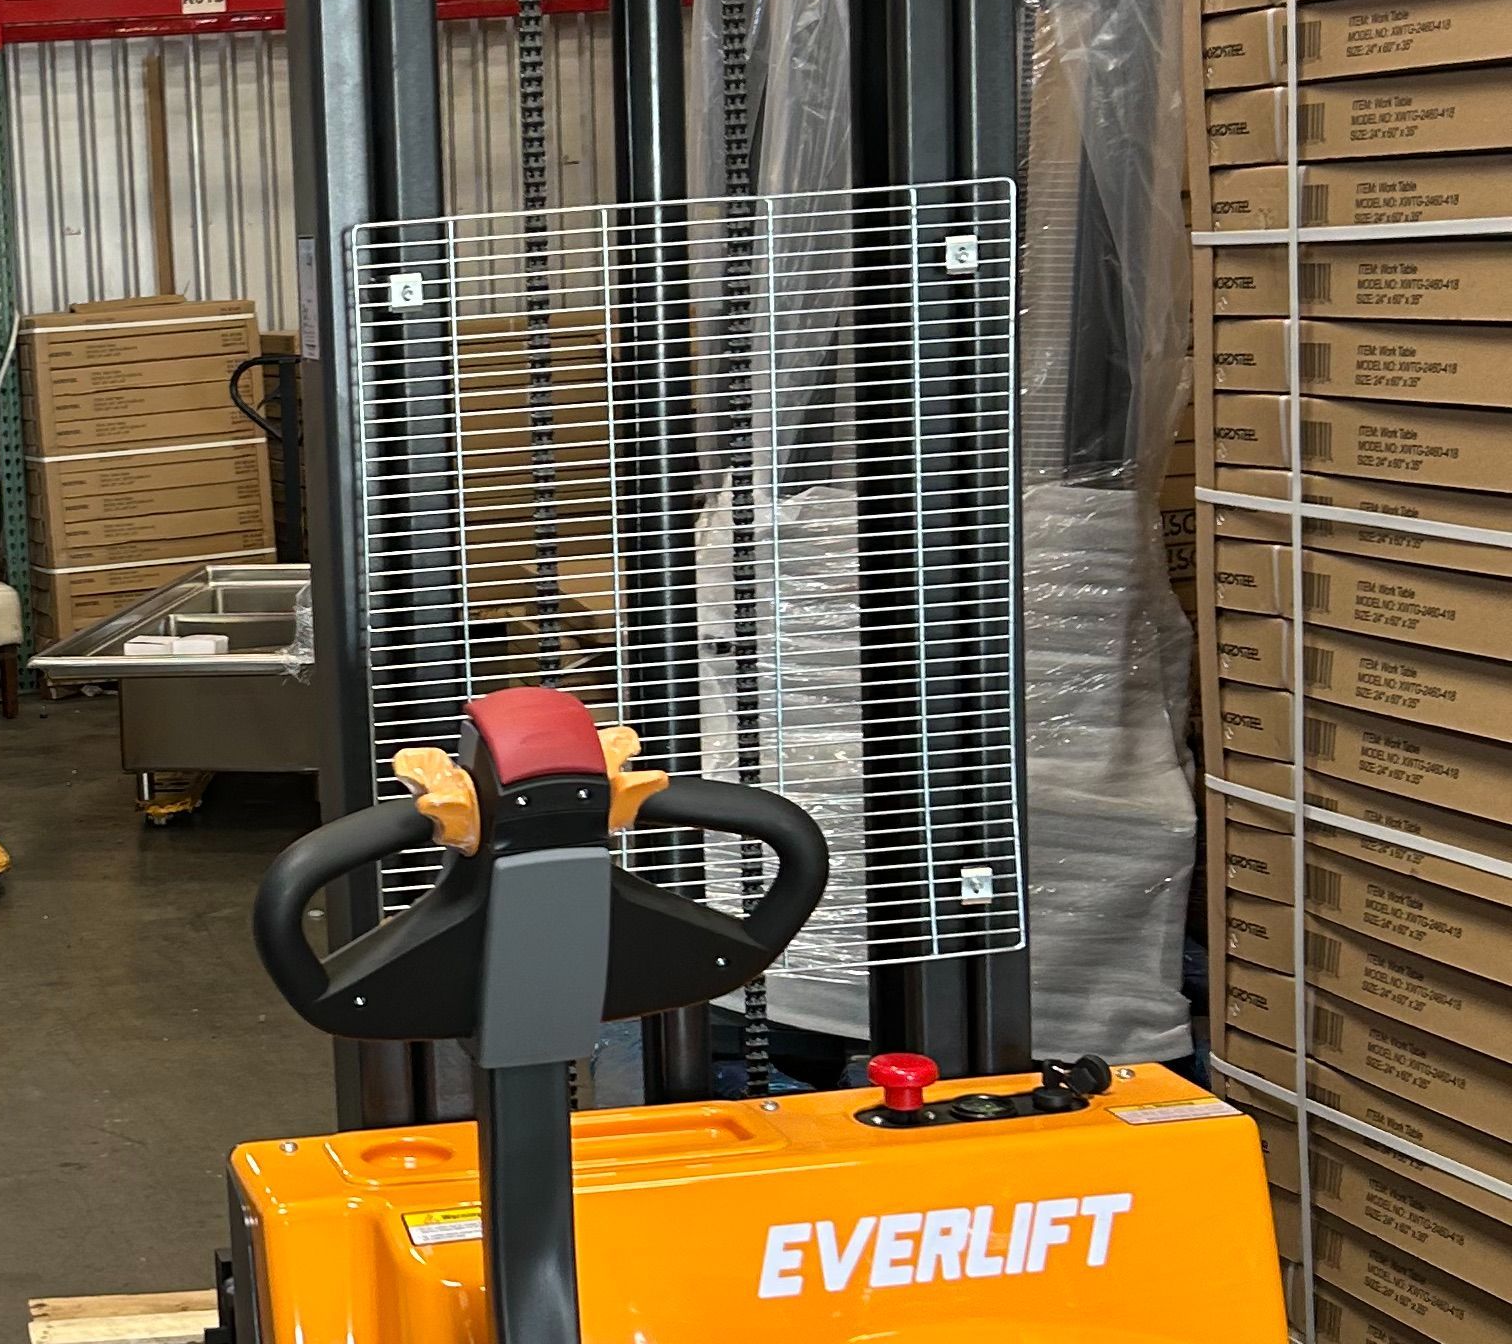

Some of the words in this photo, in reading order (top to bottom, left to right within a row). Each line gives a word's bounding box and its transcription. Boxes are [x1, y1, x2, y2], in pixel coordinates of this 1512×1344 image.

[1371, 13, 1388, 24] Work
[1390, 10, 1409, 22] Table
[1375, 98, 1391, 109] Work
[1394, 97, 1412, 107] Table
[1379, 182, 1395, 193] Work
[1398, 181, 1416, 192] Table
[1381, 264, 1397, 274] Work
[1399, 264, 1417, 274] Table
[1380, 346, 1395, 356] Work
[1398, 346, 1416, 357] Table
[1381, 427, 1397, 438] Work
[1399, 428, 1417, 440] Table
[1379, 584, 1395, 596] Work
[1397, 586, 1415, 599] Table
[1381, 662, 1397, 674] Work
[1399, 665, 1417, 678] Table
[757, 1193, 1133, 1299] EVERLIFT
